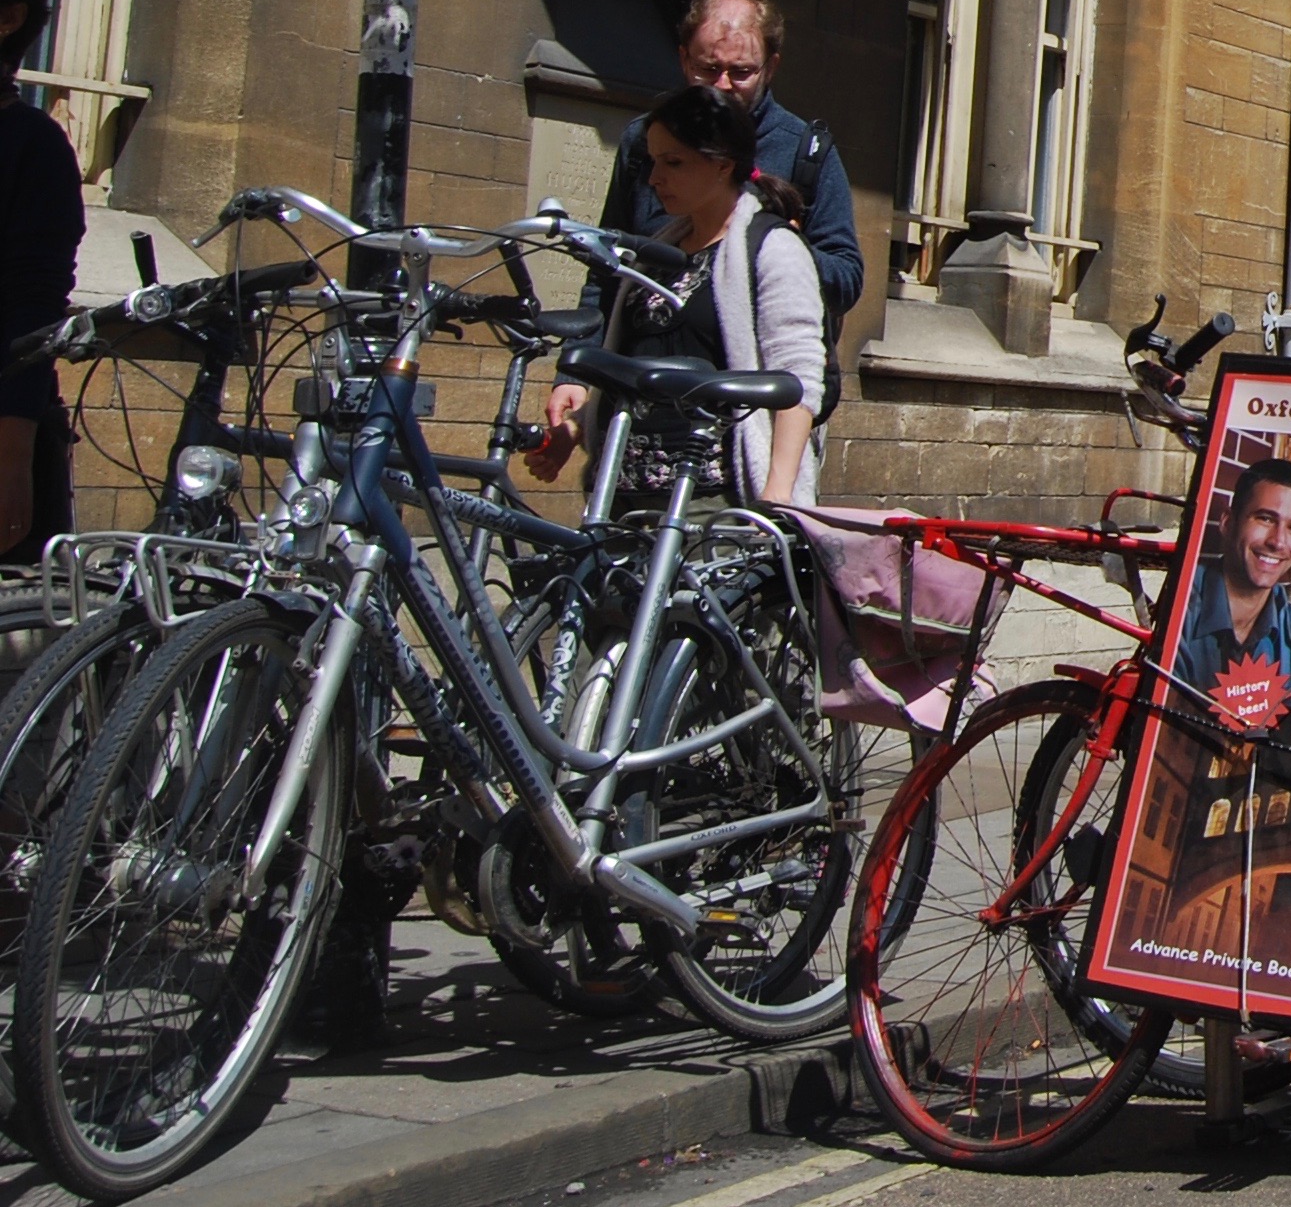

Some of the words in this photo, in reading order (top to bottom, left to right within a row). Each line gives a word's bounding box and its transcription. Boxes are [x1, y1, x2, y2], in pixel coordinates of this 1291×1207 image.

[1226, 680, 1270, 698] History
[1238, 699, 1269, 716] beer!
[299, 704, 320, 764] ZOOM
[690, 825, 738, 841] OXFORD
[1130, 937, 1199, 963] Advance
[1202, 948, 1263, 973] Private
